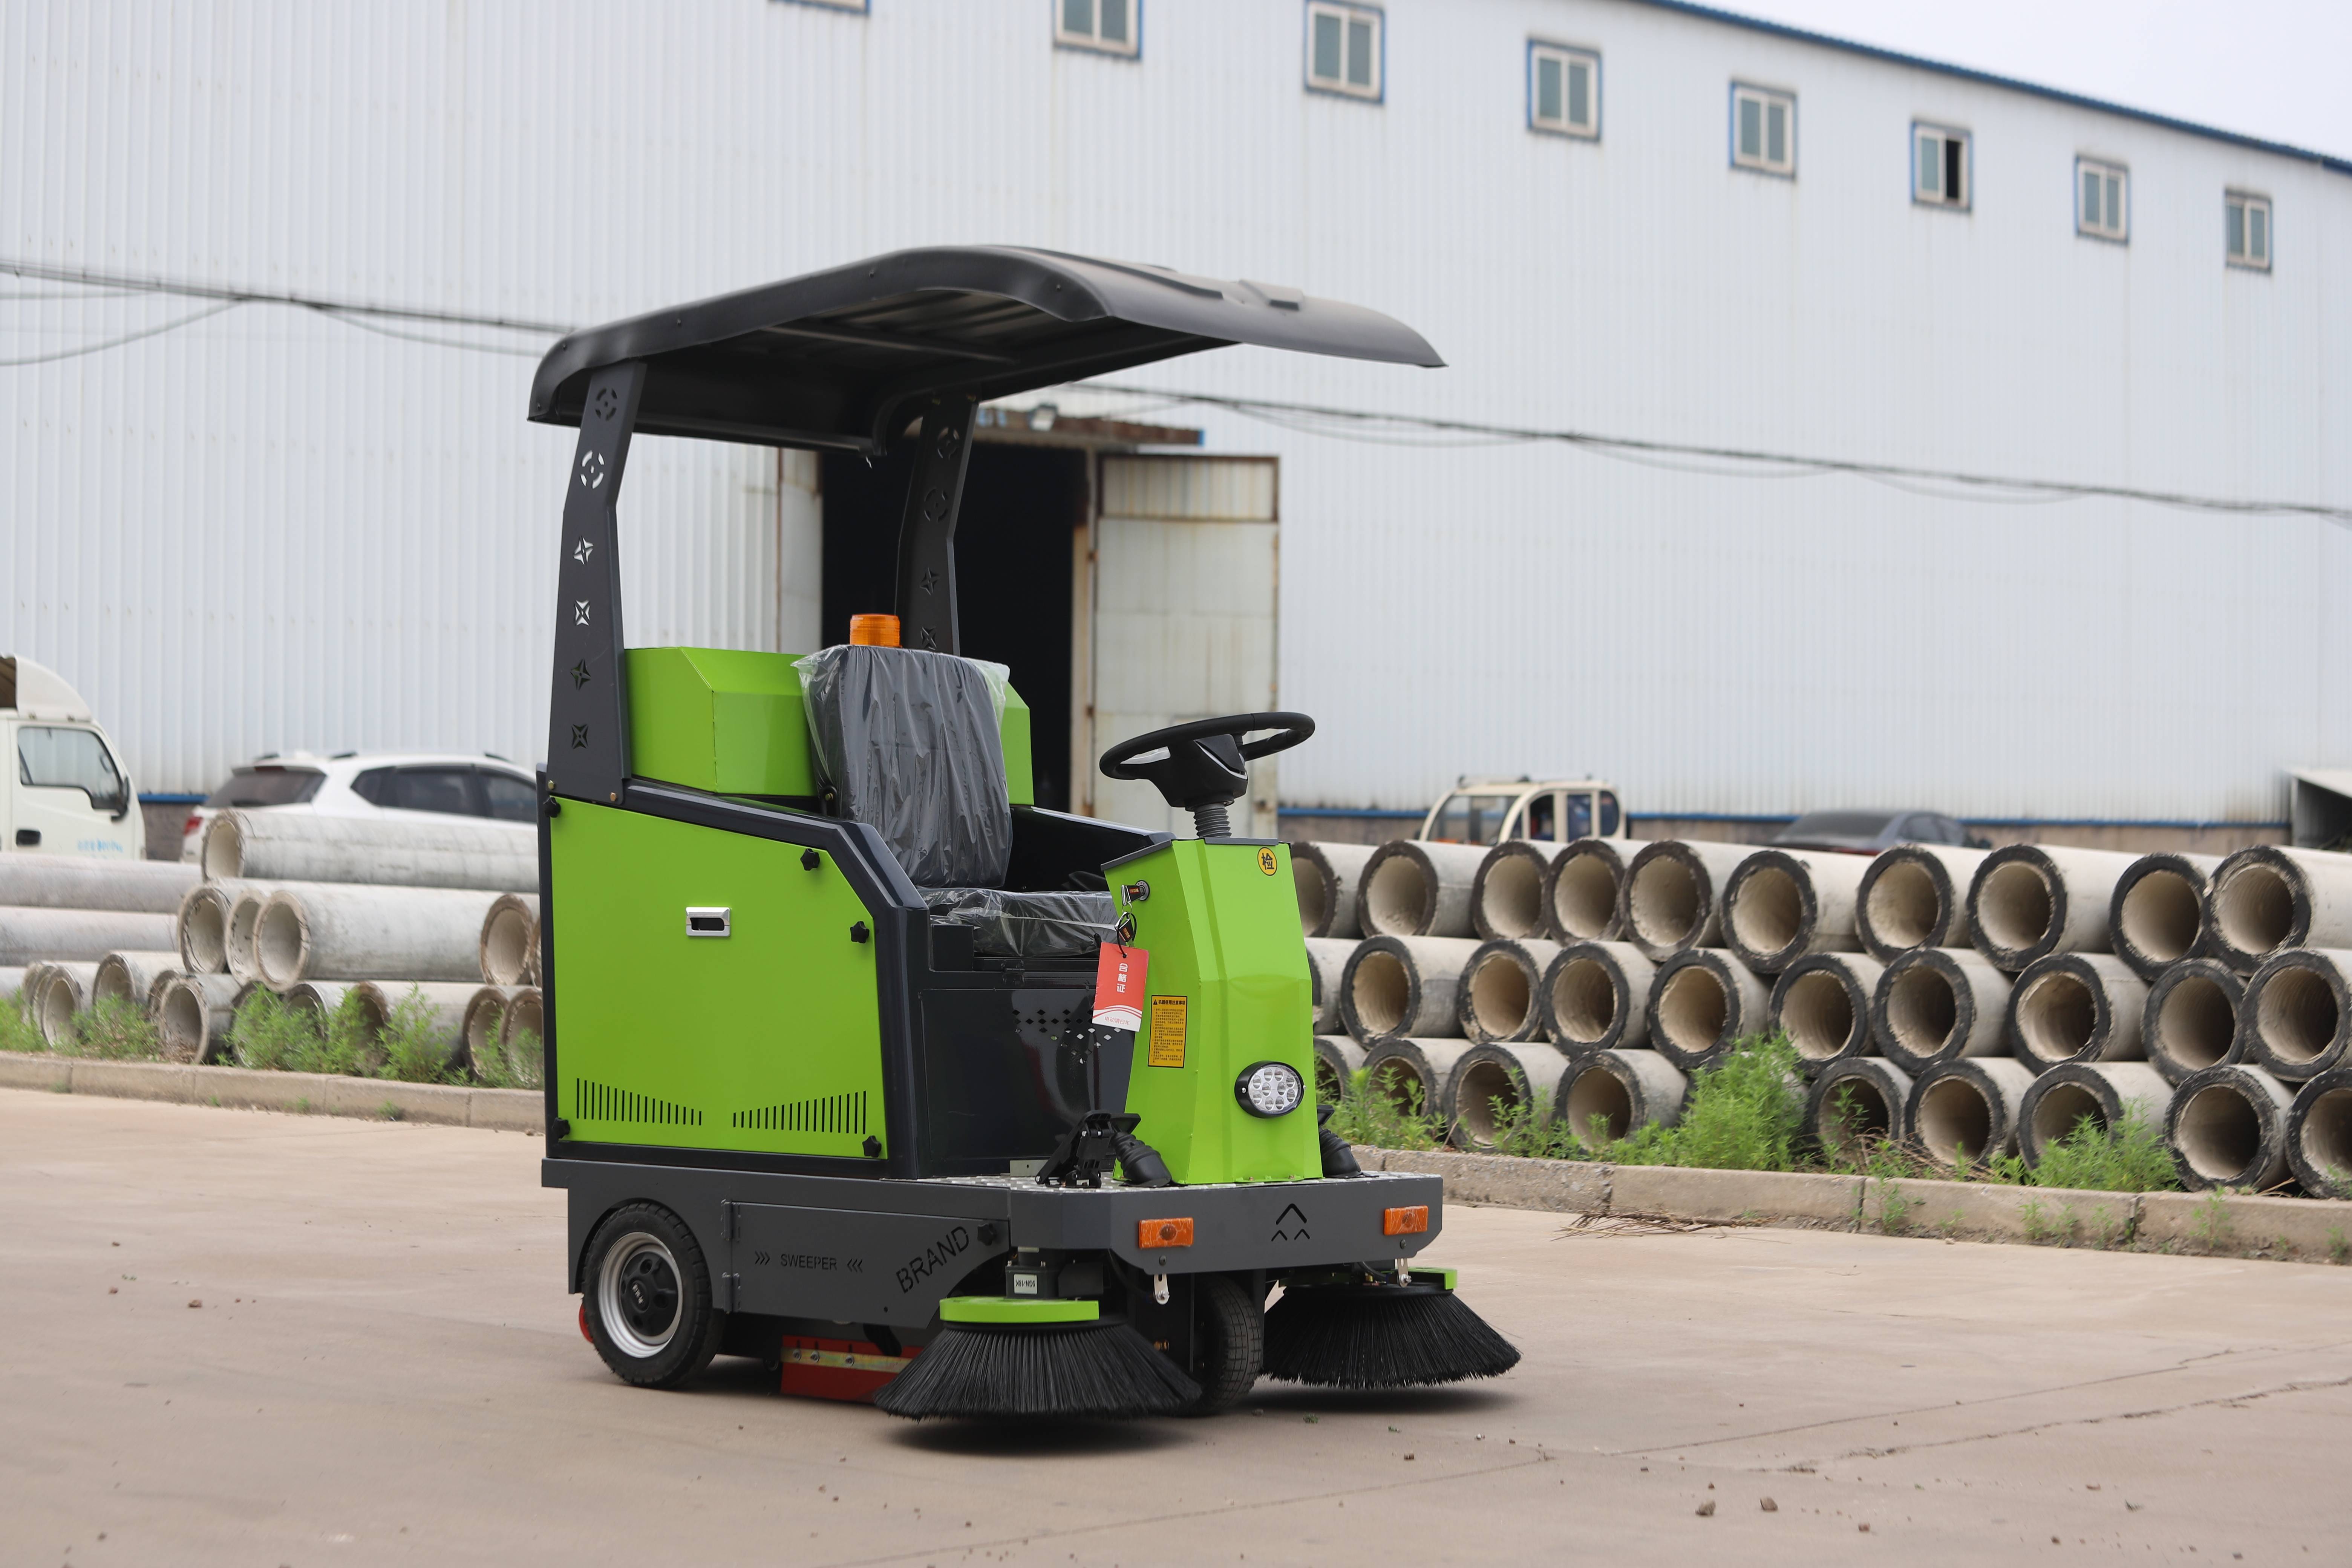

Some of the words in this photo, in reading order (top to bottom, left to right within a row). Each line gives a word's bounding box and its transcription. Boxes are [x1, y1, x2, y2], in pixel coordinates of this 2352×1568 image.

[1261, 853, 1274, 870] 检
[1116, 963, 1128, 993] 合格证
[1105, 1016, 1130, 1026] 电动清扫车
[780, 1253, 837, 1270] SWEEPER
[896, 1226, 969, 1293] BRAND
